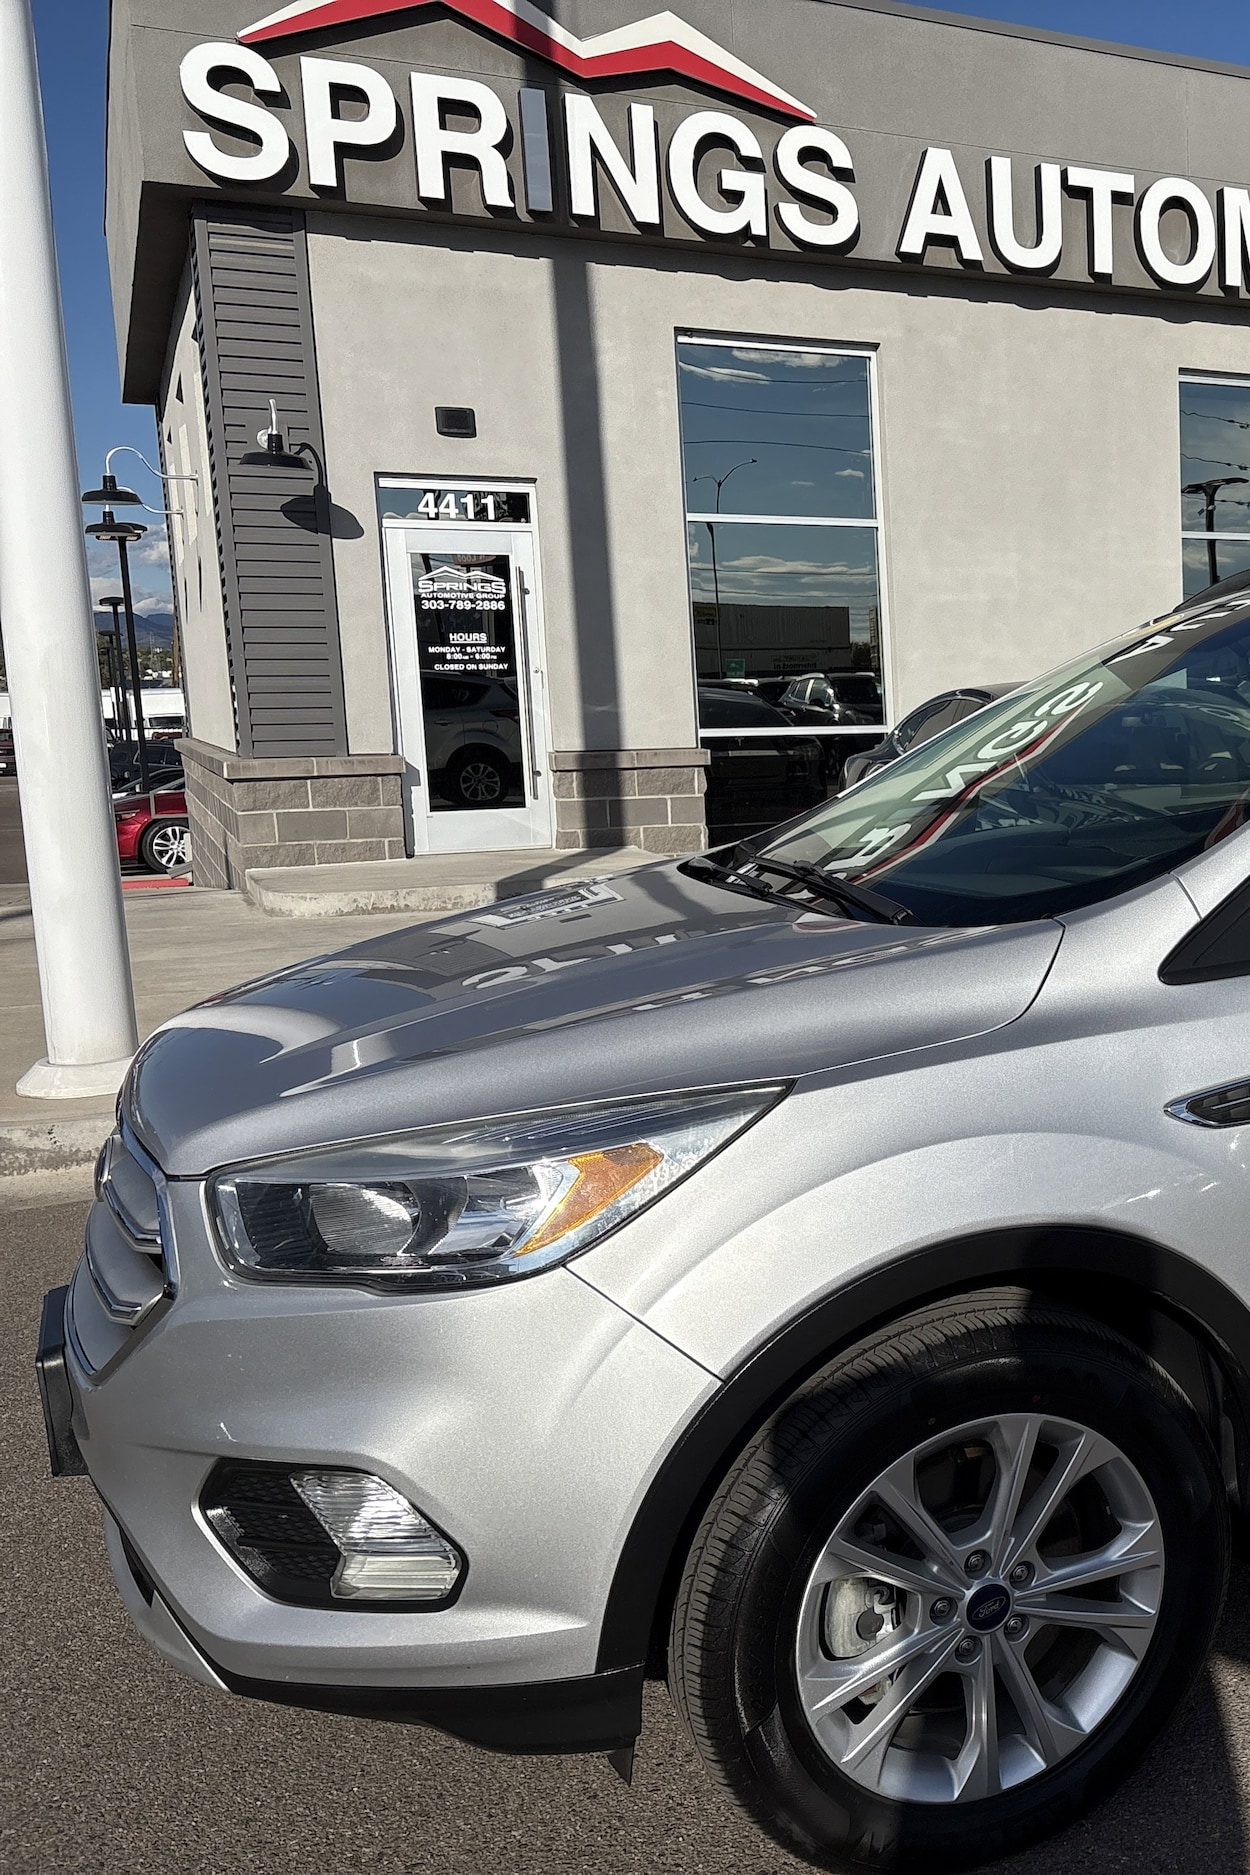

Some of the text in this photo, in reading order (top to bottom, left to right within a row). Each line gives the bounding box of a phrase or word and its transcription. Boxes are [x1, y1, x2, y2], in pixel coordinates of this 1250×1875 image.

[179, 41, 861, 246] SPRINGS
[417, 492, 495, 520] 4411
[418, 580, 507, 594] SPRINGS
[421, 600, 506, 611] 303-789-2886
[449, 632, 488, 642] HOURS
[434, 663, 509, 671] CLOSED ON SUNDAY
